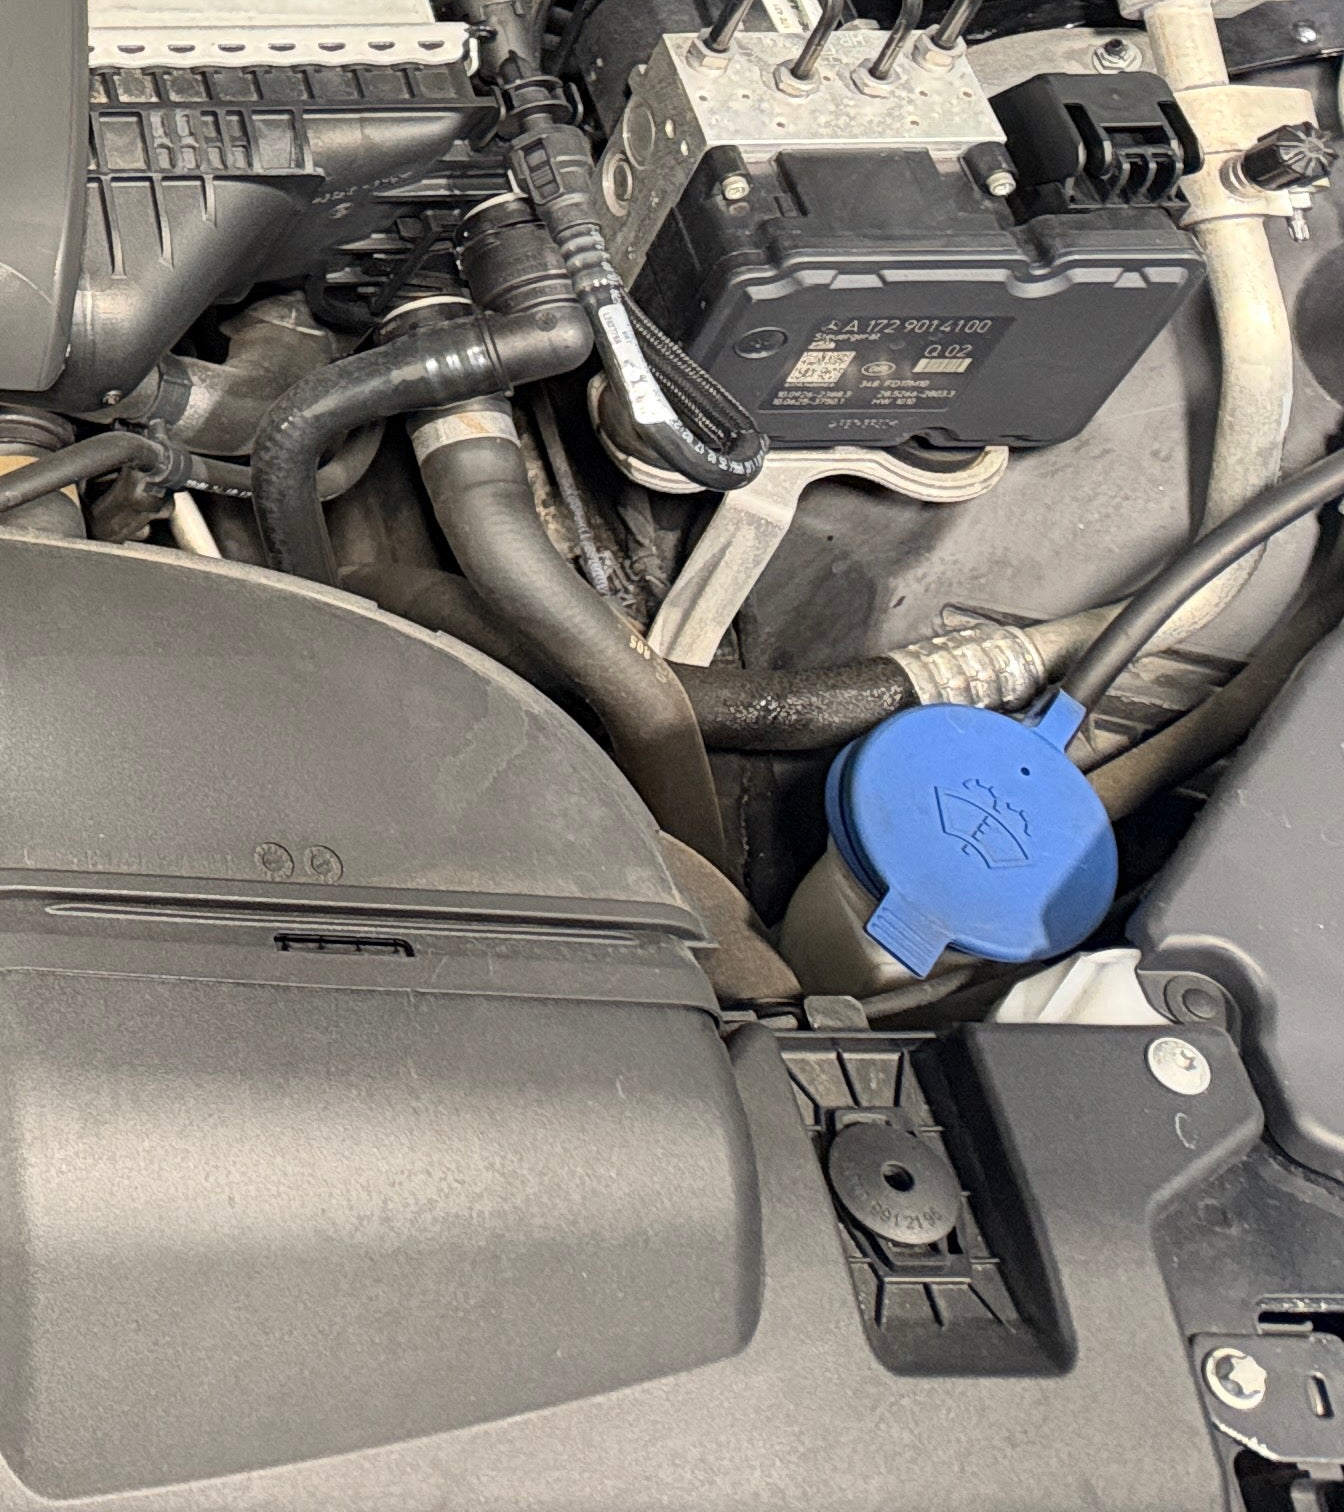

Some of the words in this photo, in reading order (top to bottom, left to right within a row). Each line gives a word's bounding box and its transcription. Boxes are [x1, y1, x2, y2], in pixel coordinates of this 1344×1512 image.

[842, 320, 859, 333] A
[866, 319, 900, 333] 172
[904, 318, 993, 334] 9014100
[924, 344, 943, 358] Q
[945, 344, 973, 357] 02
